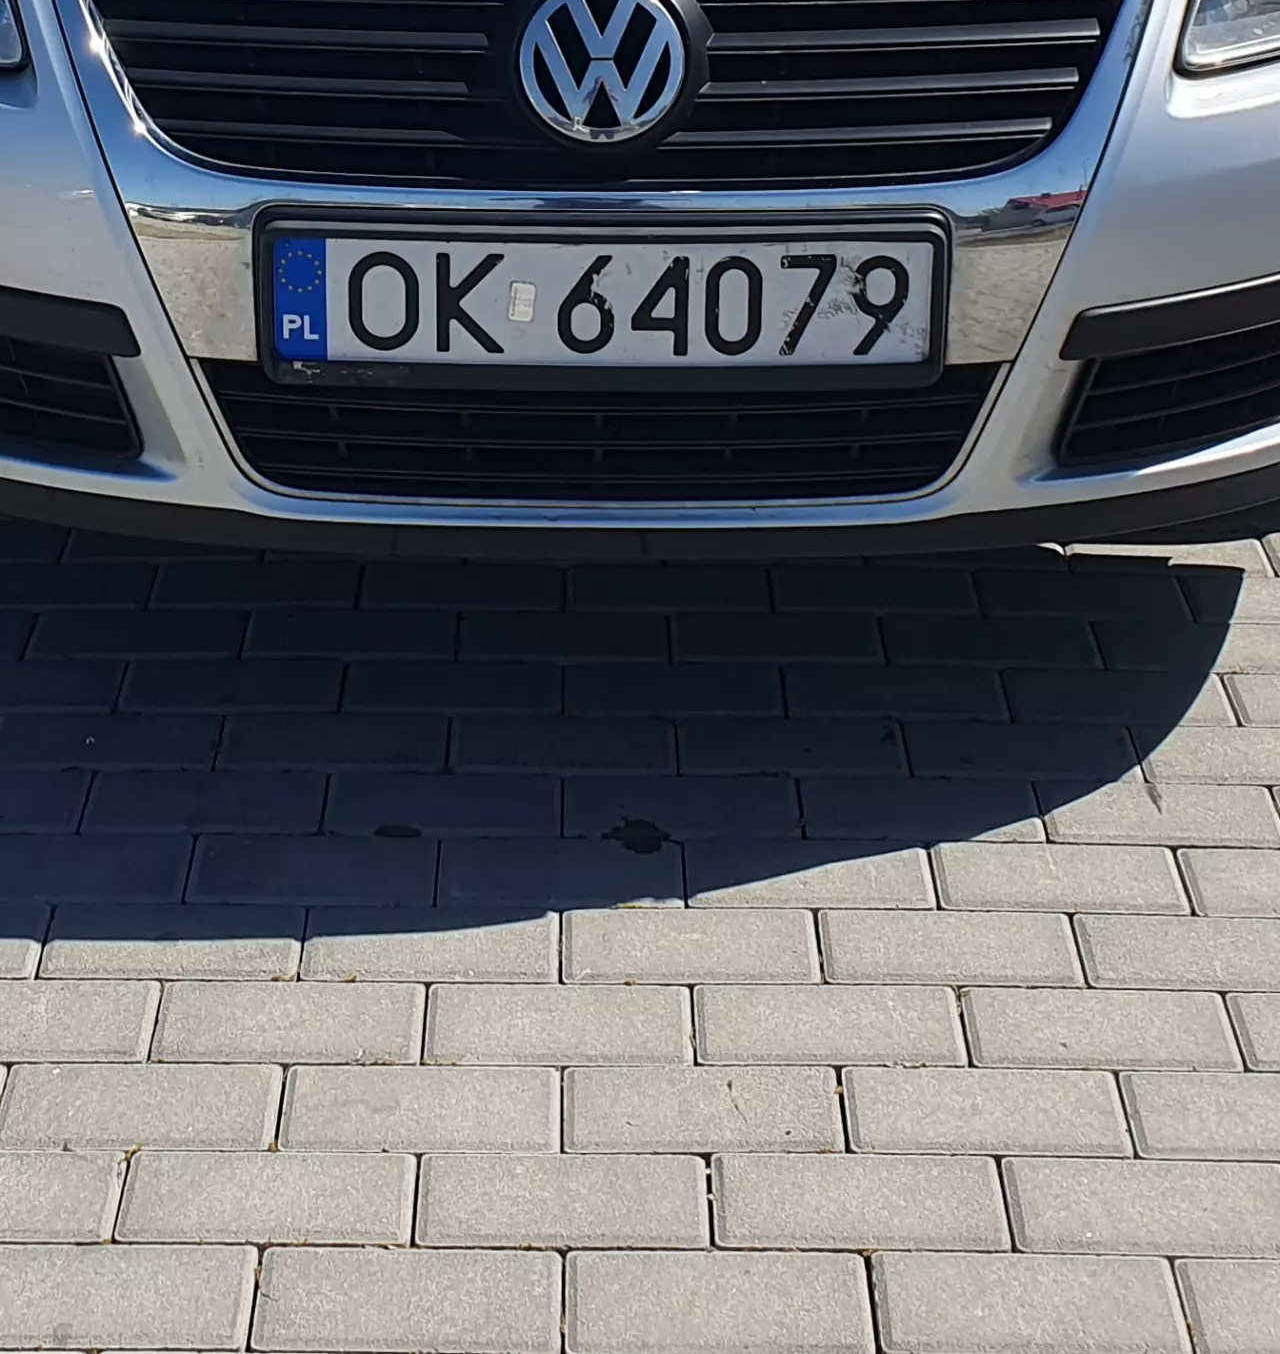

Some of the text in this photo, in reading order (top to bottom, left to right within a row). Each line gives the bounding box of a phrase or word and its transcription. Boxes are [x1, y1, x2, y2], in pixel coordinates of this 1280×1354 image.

[282, 314, 319, 340] PL
[348, 251, 910, 356] OK 64079
